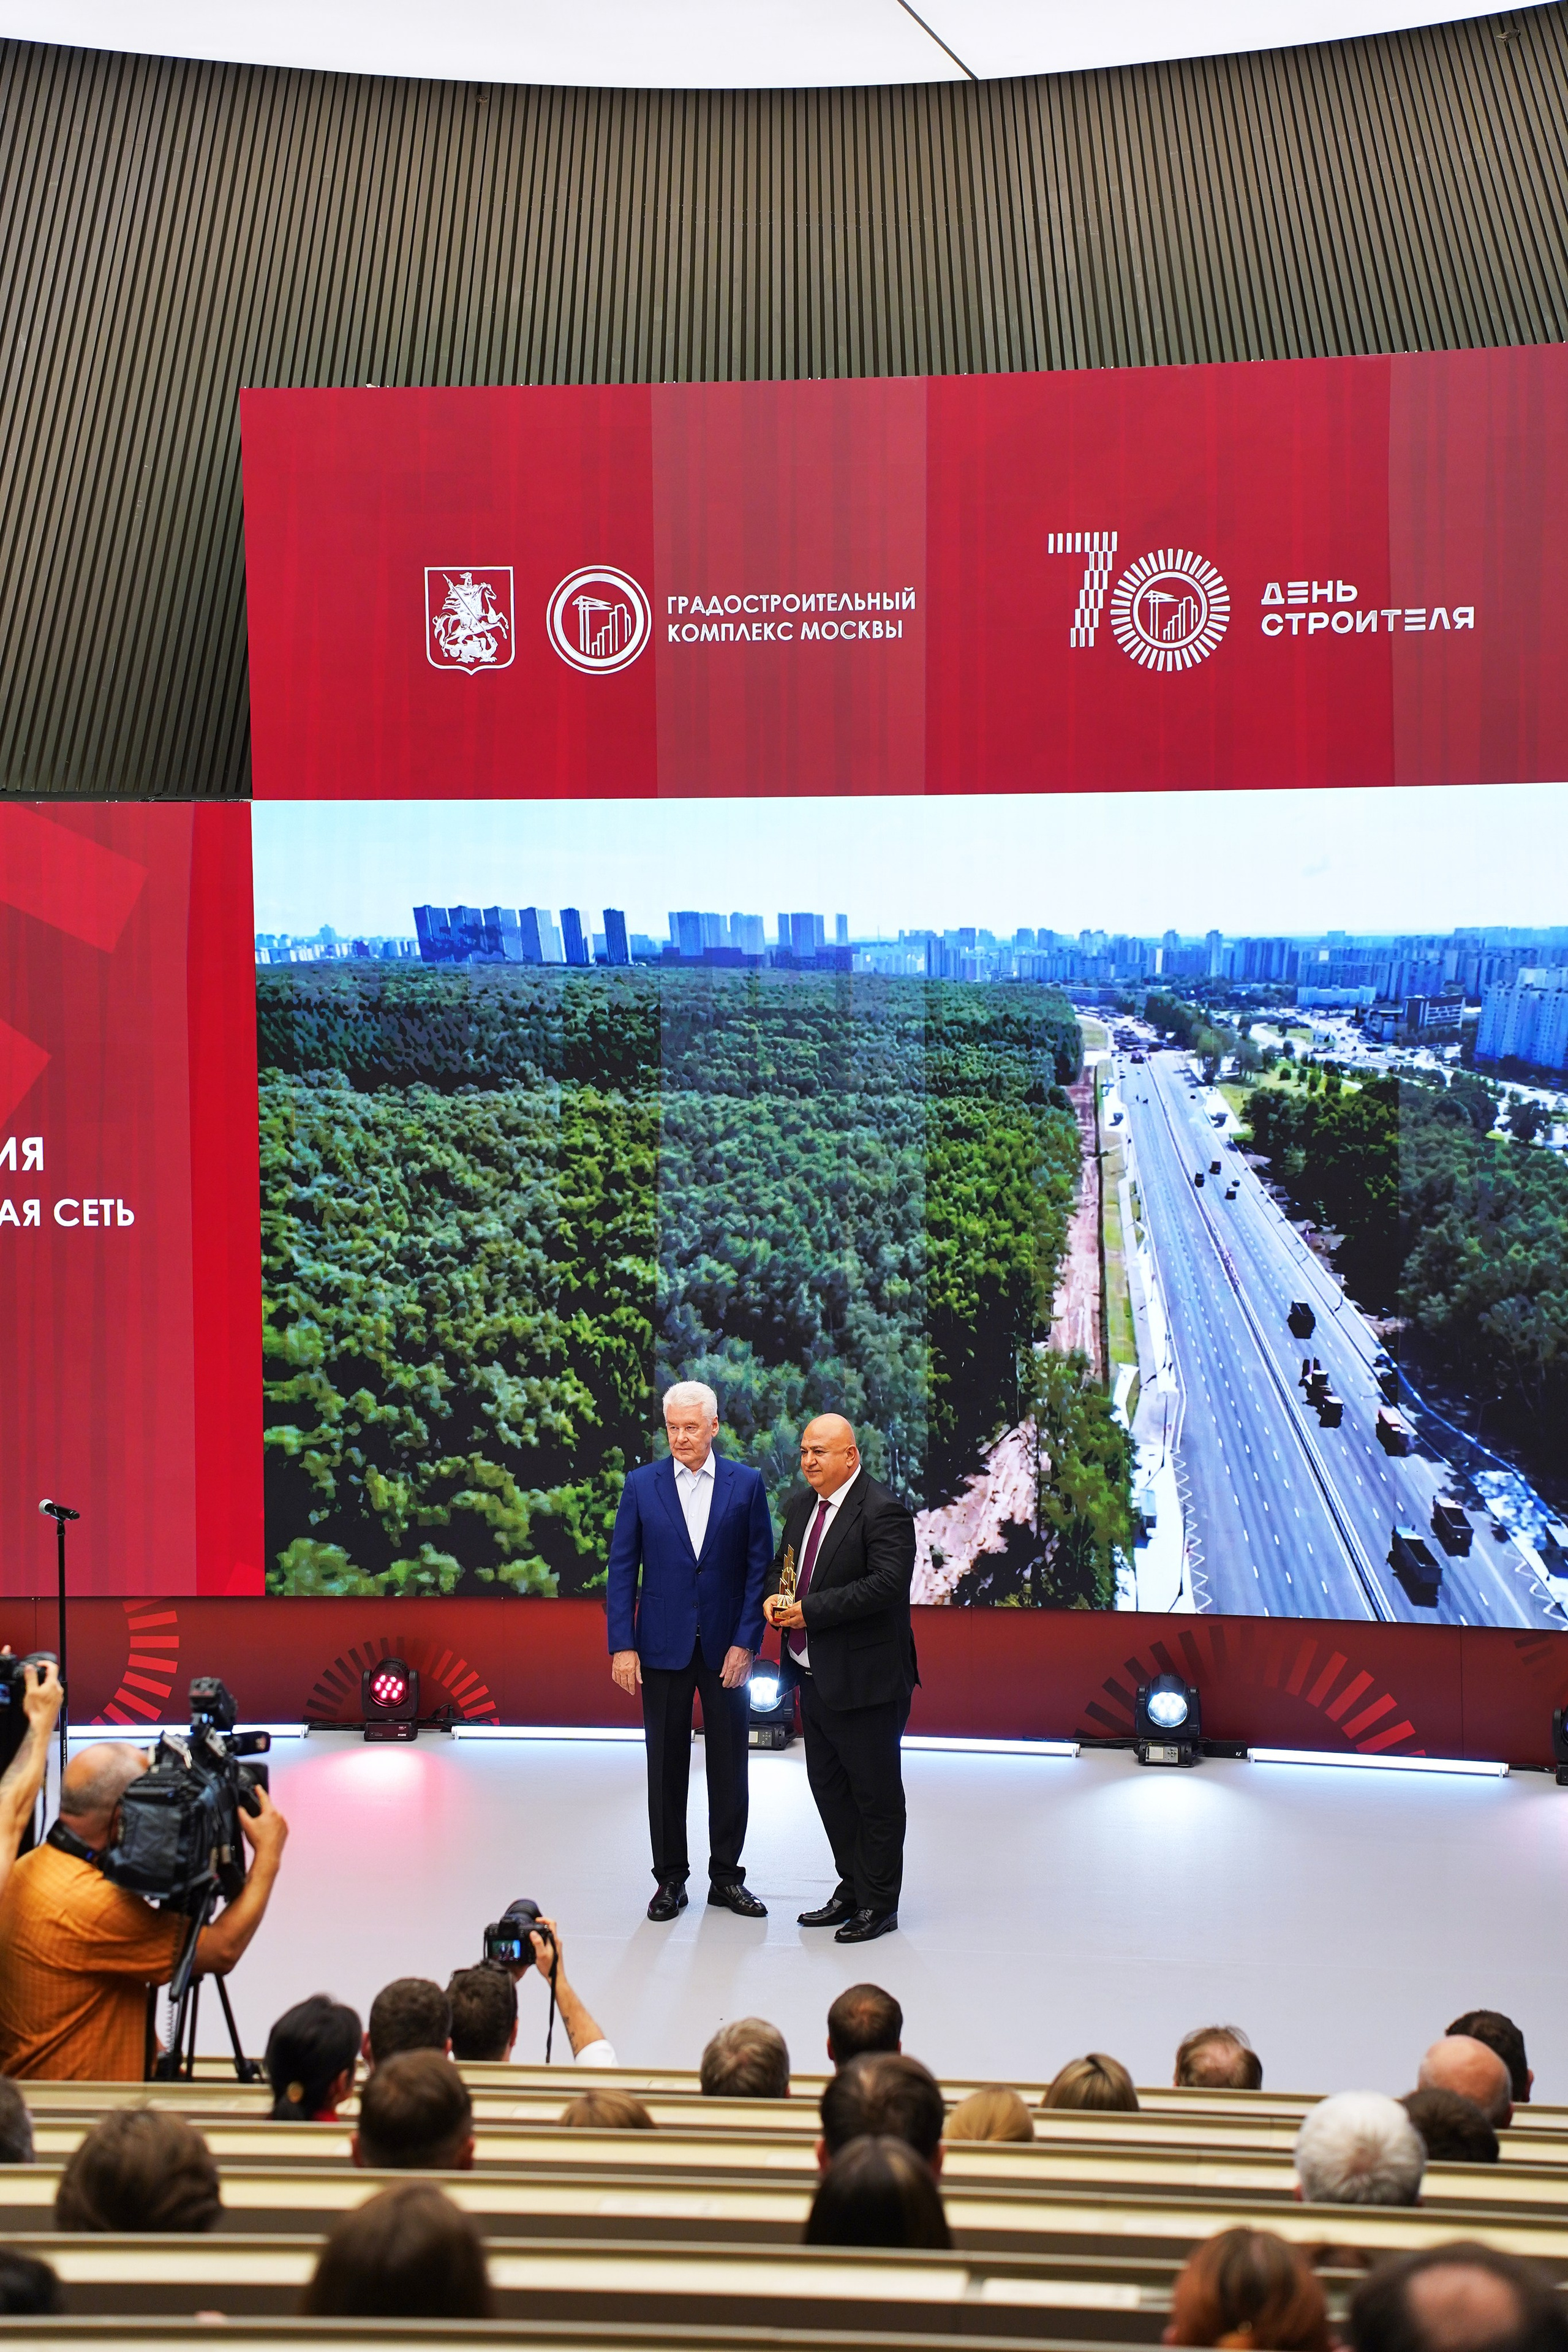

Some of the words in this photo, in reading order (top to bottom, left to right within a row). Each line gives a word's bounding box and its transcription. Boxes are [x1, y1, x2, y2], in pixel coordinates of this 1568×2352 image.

[667, 586, 916, 616] ГРАДОСТРОИТЕЛЬНЫЙ
[1261, 579, 1358, 605] ДЕНЬ
[667, 622, 794, 643] КОМПЛЕКС
[800, 619, 903, 640] МОСКВЫ
[1261, 606, 1475, 636] СТРОИТЕЛЯ
[53, 1198, 135, 1227] СЕТЬ
